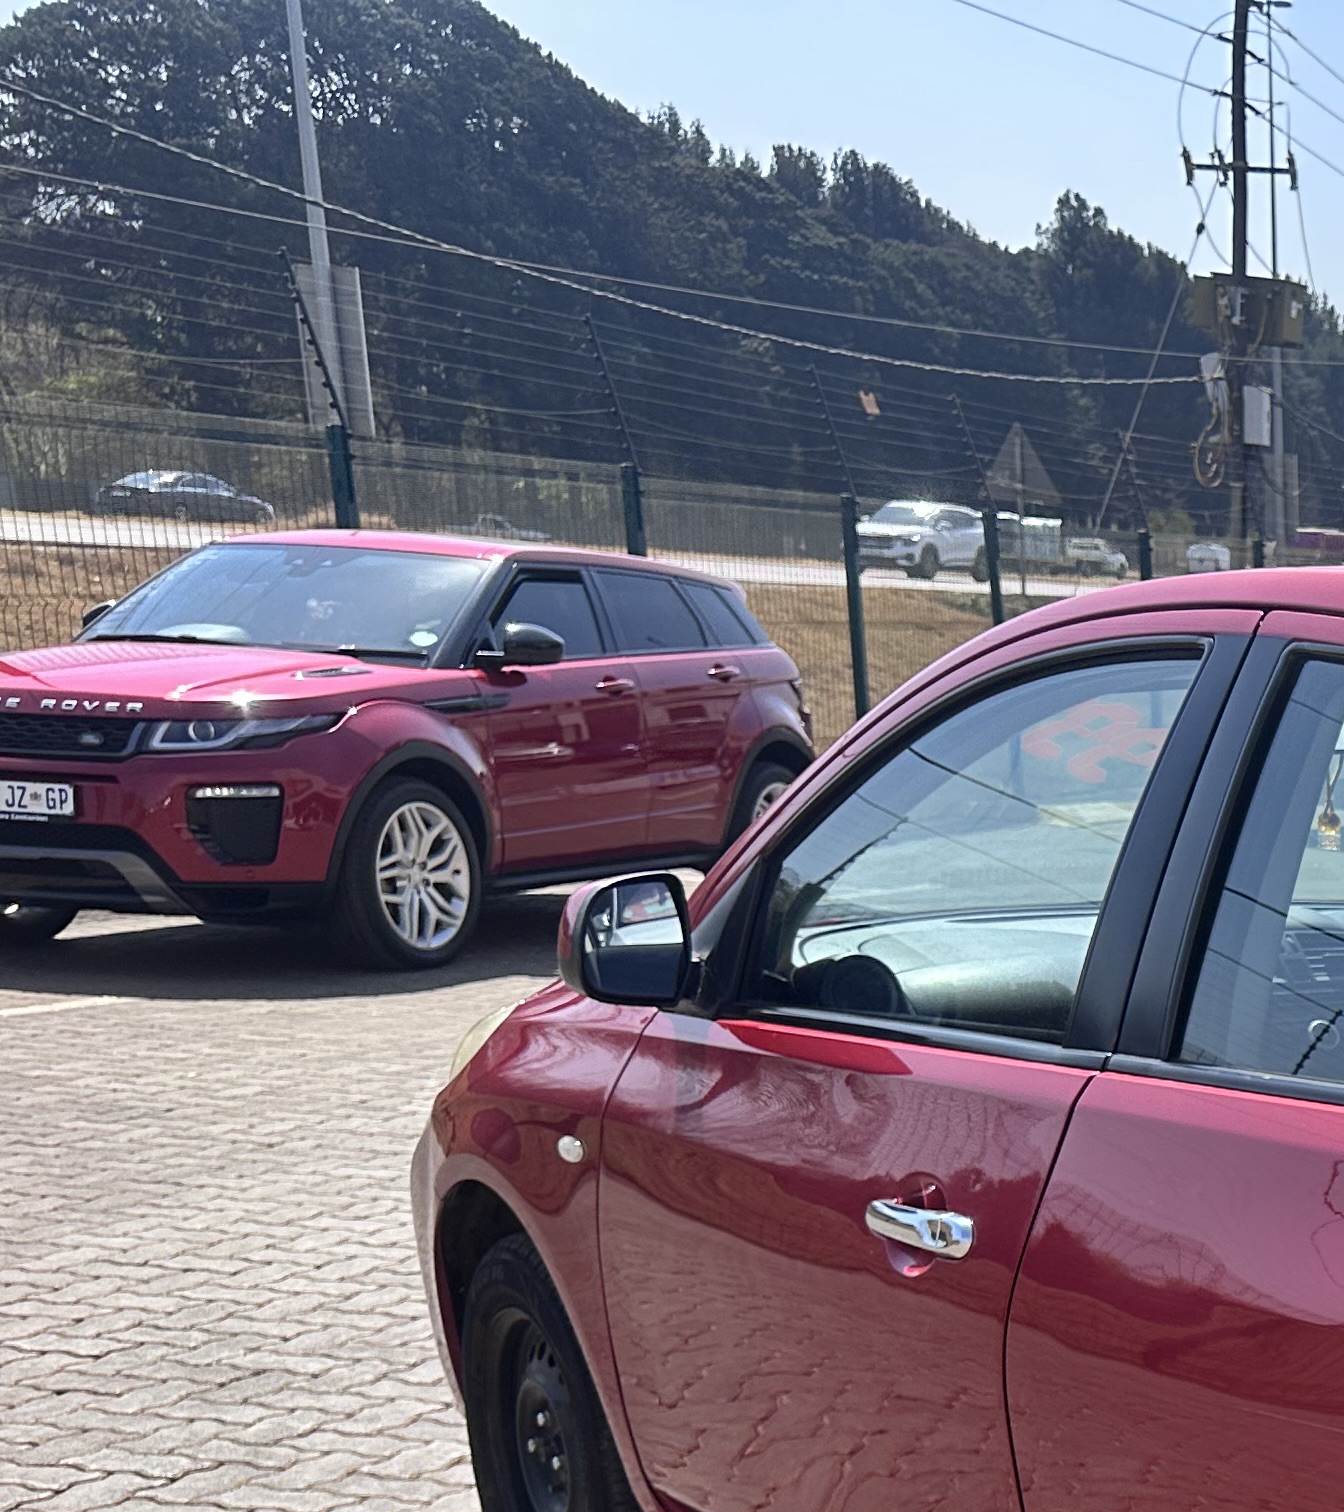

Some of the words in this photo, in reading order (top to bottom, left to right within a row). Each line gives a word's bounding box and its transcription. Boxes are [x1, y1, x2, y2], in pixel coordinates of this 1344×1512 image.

[41, 698, 143, 713] ROVER
[5, 784, 28, 809] JZ
[45, 787, 69, 811] GP
